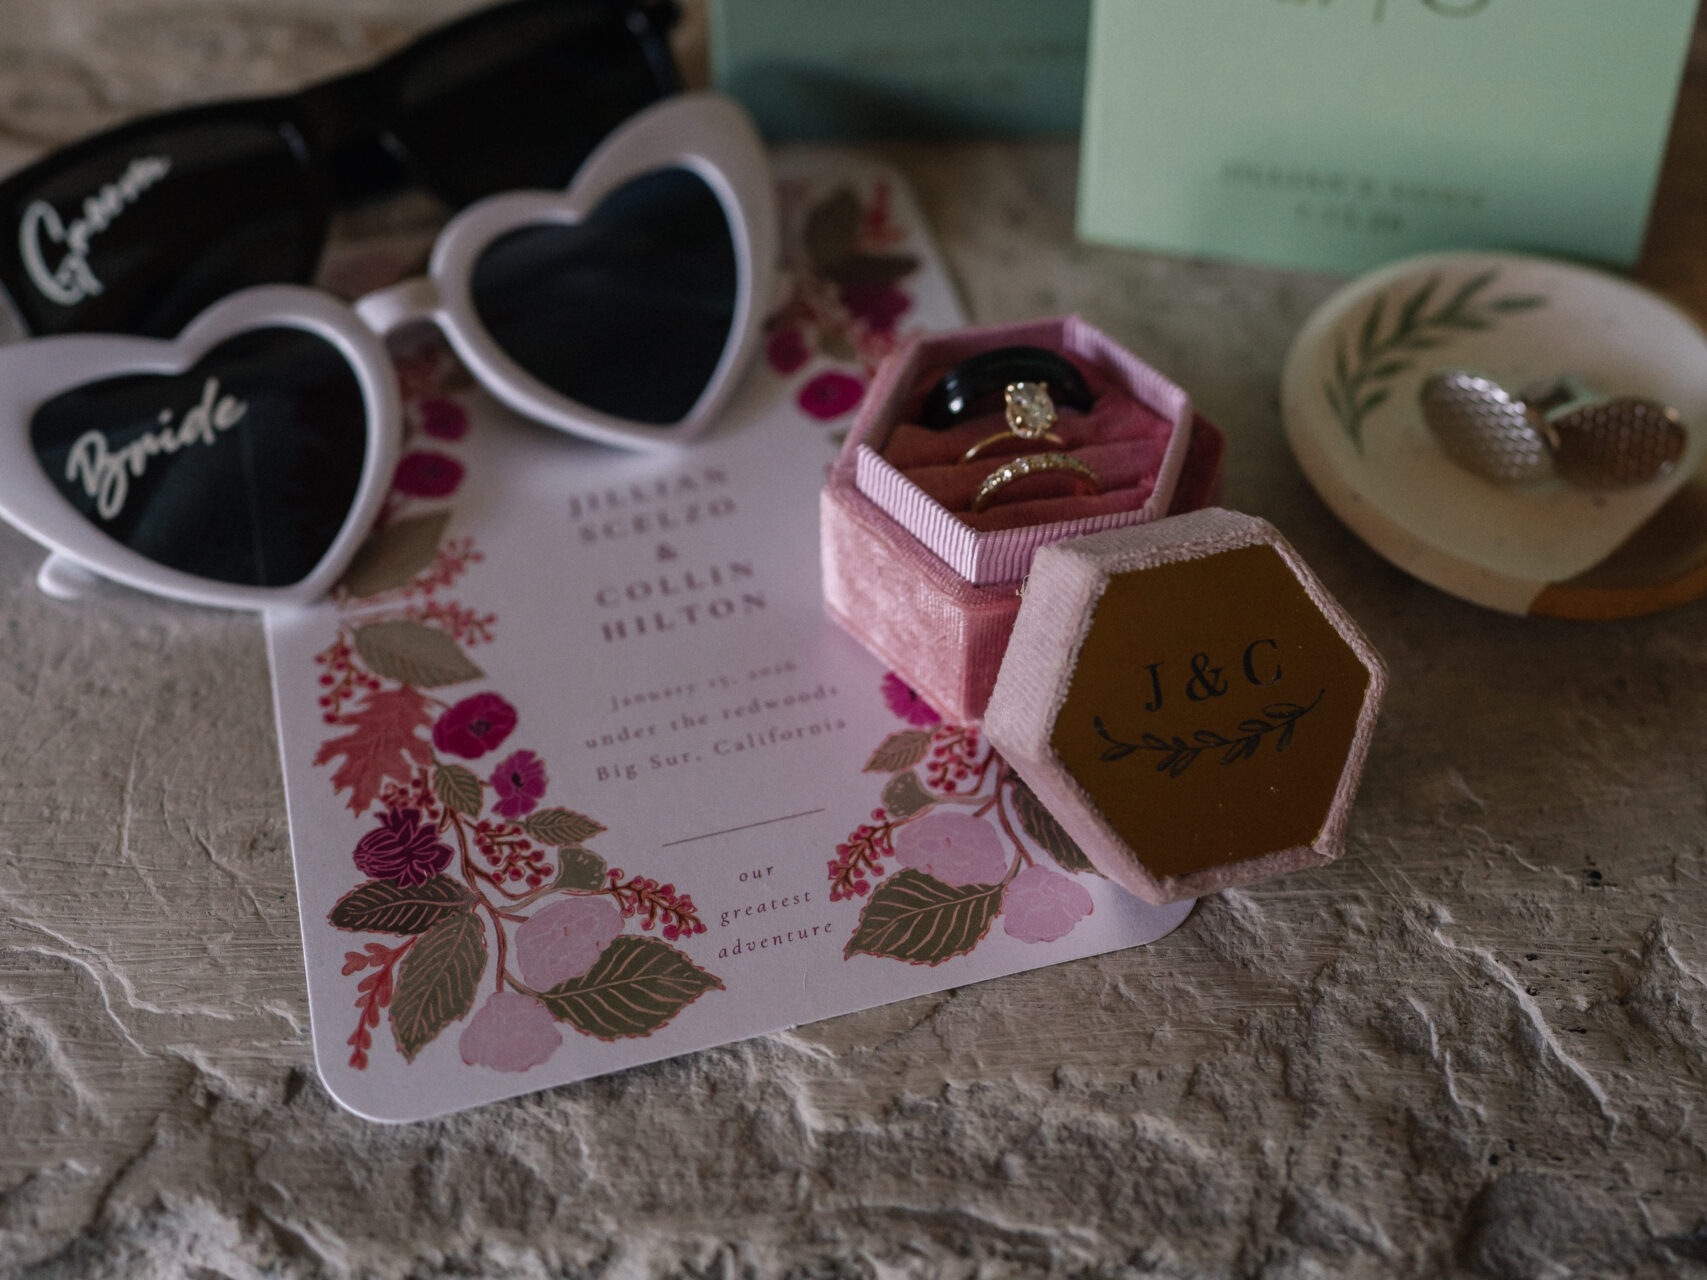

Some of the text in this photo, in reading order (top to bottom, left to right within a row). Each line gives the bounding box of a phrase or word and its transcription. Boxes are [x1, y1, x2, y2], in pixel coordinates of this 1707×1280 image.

[65, 375, 247, 520] Bride
[594, 559, 755, 610] COLLIN
[601, 590, 768, 643] HILTON
[1144, 638, 1283, 712] J & C
[584, 682, 840, 749] under the redwoods
[596, 762, 639, 783] Big
[712, 716, 848, 757] California
[738, 864, 775, 883] our
[720, 891, 812, 928] greatest
[718, 922, 833, 959] adventure
